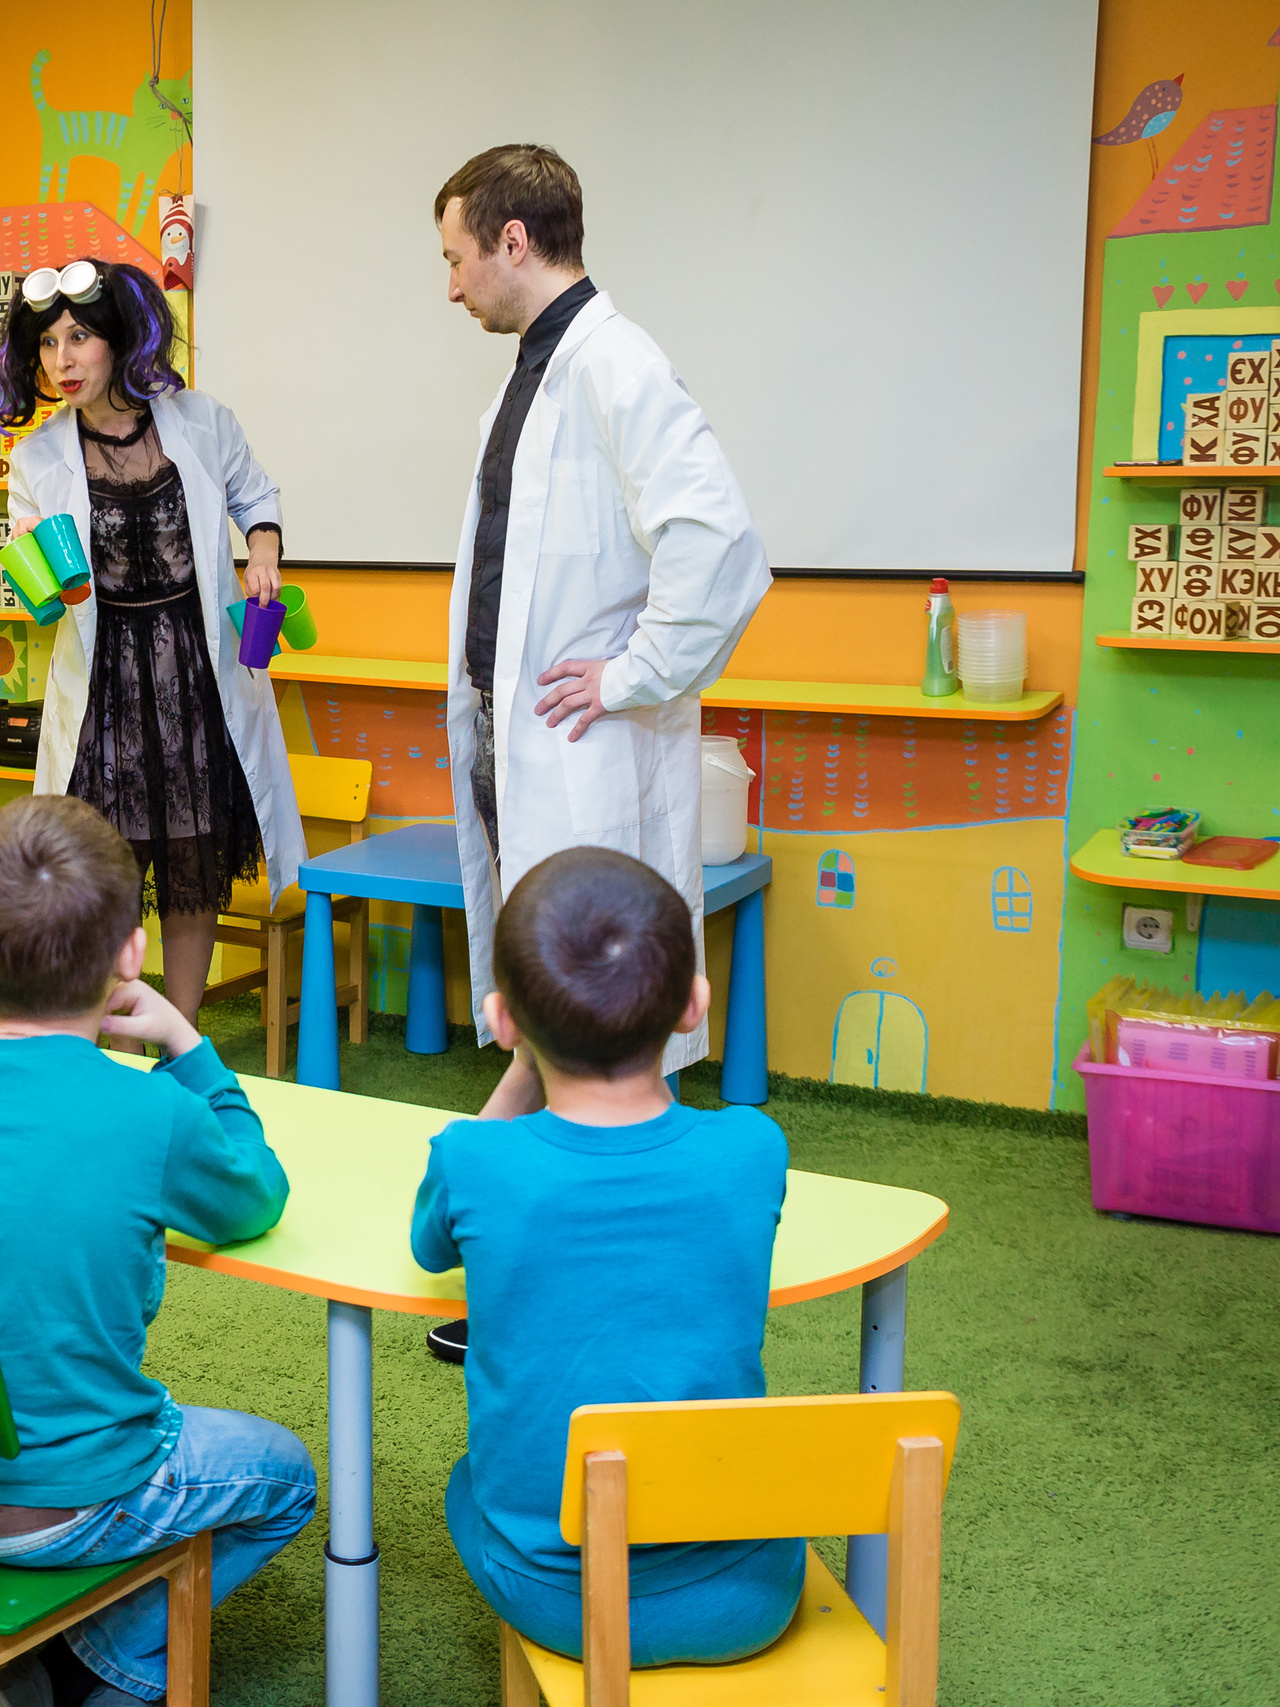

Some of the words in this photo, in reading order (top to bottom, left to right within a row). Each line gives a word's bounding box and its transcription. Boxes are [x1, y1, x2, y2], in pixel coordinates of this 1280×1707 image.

[1229, 357, 1267, 385] ХЭ
[1190, 395, 1221, 429] ХА
[1228, 396, 1266, 424] ФУ
[1189, 436, 1219, 462] К
[1229, 431, 1261, 465] ФУ
[1182, 494, 1219, 521] ФУ
[1227, 489, 1258, 522] КЫ
[1133, 526, 1162, 559] ХА
[1185, 527, 1216, 561] ФУ
[1226, 527, 1256, 560] КУ
[1138, 566, 1174, 593] ХУ
[1182, 564, 1213, 598] ФЭ
[1220, 568, 1255, 595] КЭ
[3, 588, 16, 607] ГЯ
[1136, 599, 1165, 632] ХЭ
[1190, 607, 1223, 636] КО
[1255, 605, 1280, 639] КО
